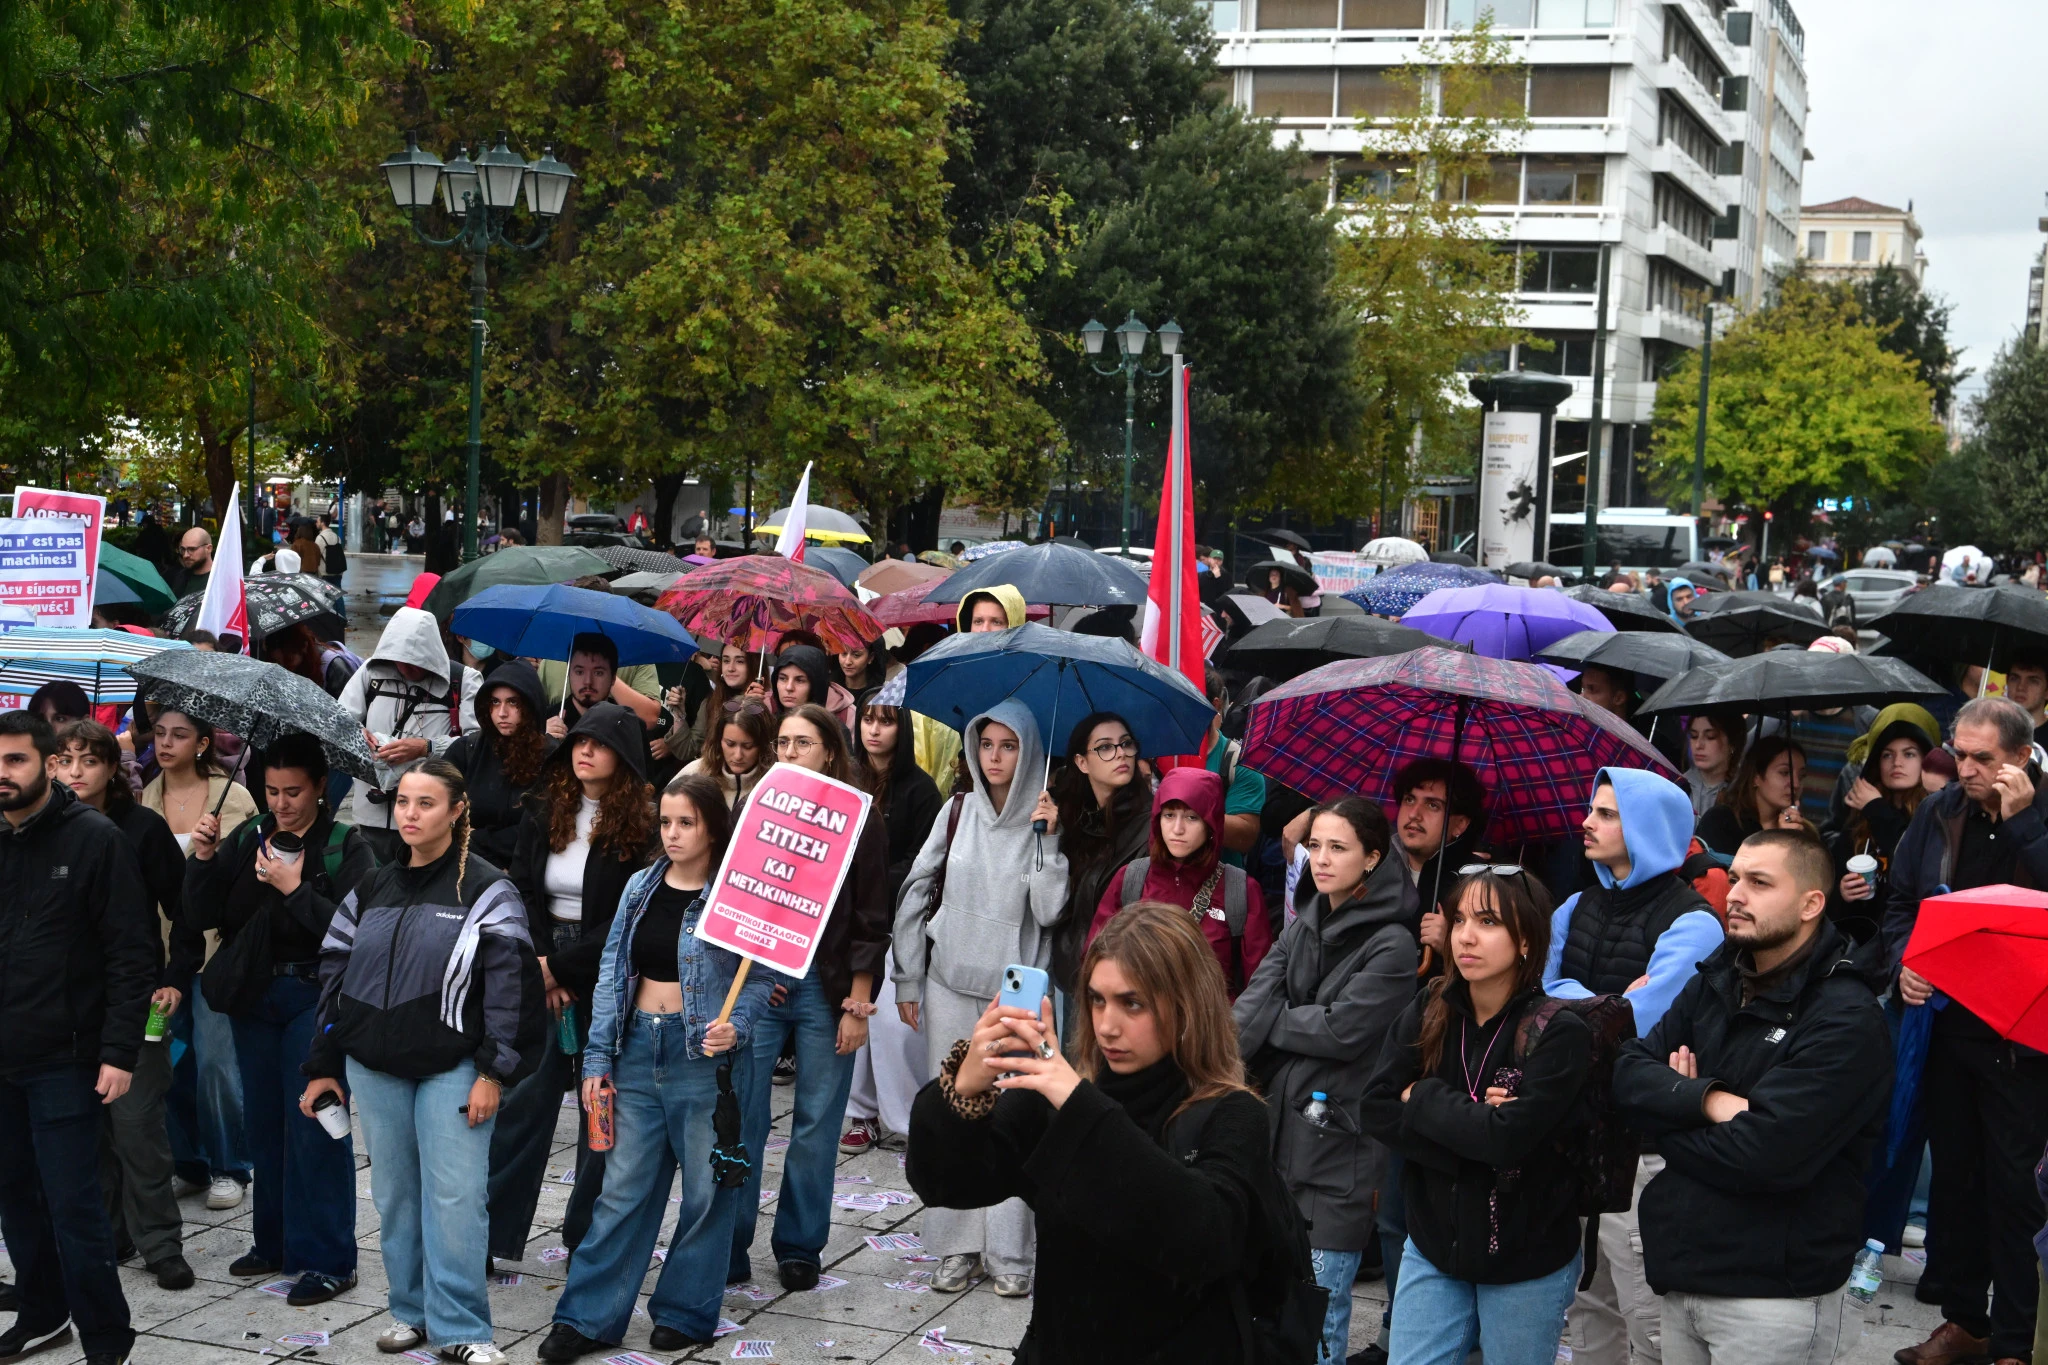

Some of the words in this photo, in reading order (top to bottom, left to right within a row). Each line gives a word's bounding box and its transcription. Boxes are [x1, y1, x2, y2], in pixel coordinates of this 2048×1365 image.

[32, 536, 53, 547] est
[57, 537, 82, 549] pas
[2, 553, 73, 566] machines!
[0, 584, 23, 595] Δεν
[26, 583, 78, 596] είμαστε
[759, 788, 848, 834] ΔΩΡΕΑΝ
[757, 821, 829, 862] ΣΙΤΙΣΗ
[763, 858, 796, 882] ΚΑΙ
[728, 870, 823, 918] ΜΕΤΑΚΙΝΗΣΗ
[717, 905, 761, 929] ΦΟΙΤΗΤΙΚΟΙ
[761, 922, 806, 945] ΣΥΛΛΟΓΟΙ
[738, 929, 772, 947] ΑΘΗΝΑΣ
